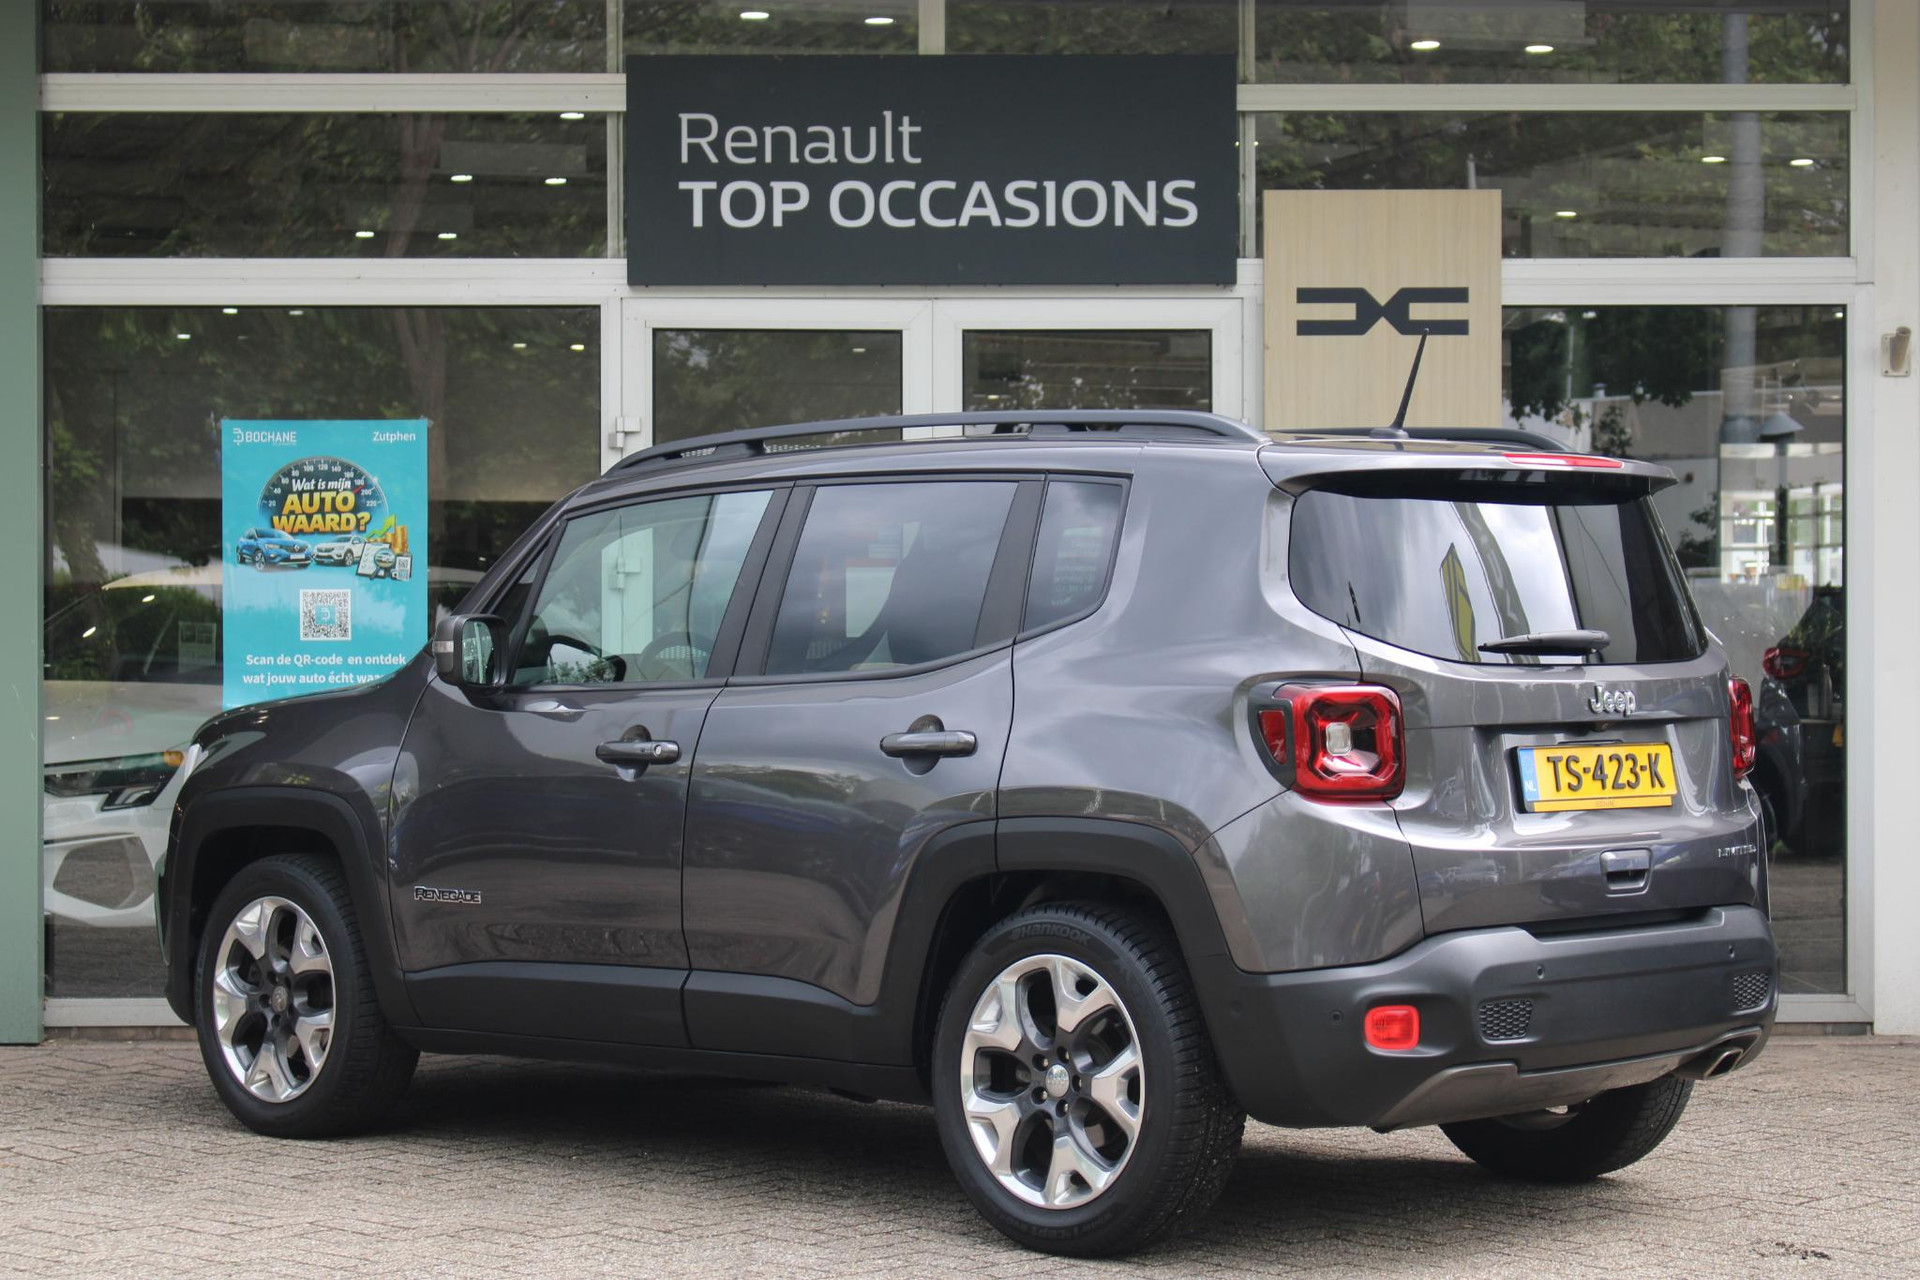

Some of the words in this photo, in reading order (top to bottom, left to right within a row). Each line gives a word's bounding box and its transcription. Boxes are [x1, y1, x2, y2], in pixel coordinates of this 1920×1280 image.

[678, 110, 922, 165] Renault
[678, 180, 810, 229] TOP
[828, 179, 1199, 229] OCCASIONS
[245, 431, 297, 443] BOCHANE
[372, 431, 416, 443] Zutphen
[292, 478, 315, 492] Wat
[317, 478, 327, 490] is
[327, 477, 351, 492] mijn
[281, 490, 355, 515] AUTO
[272, 511, 371, 533] WAARD?
[246, 654, 274, 666] Scan
[276, 654, 292, 666] de
[293, 654, 343, 668] QR-code
[347, 656, 363, 666] en
[364, 654, 406, 666] ontdek
[243, 673, 265, 684] wat
[266, 672, 296, 686] jouw
[299, 673, 326, 684] auto
[328, 670, 354, 684] écht
[1588, 684, 1636, 717] Jeep
[1547, 752, 1665, 792] TS-423-K
[1524, 780, 1537, 792] NL
[414, 885, 482, 904] RENEGADE
